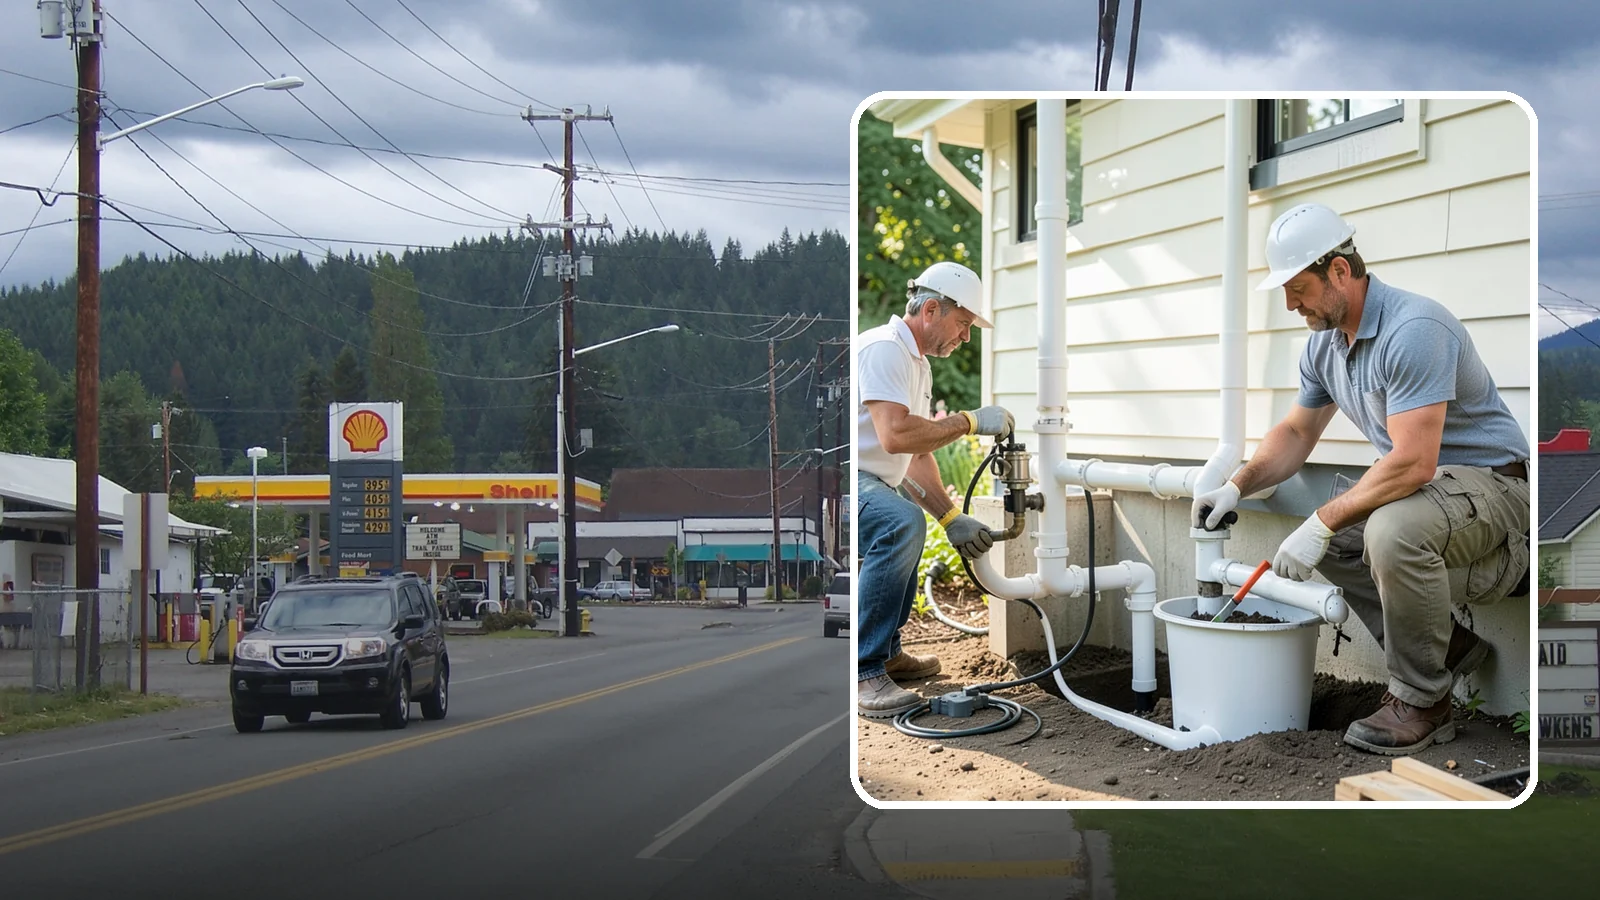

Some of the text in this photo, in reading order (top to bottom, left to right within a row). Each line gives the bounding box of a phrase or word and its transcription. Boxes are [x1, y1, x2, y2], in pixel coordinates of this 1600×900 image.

[365, 480, 383, 490] 395
[490, 484, 547, 499] Shell
[365, 494, 383, 504] 405
[365, 508, 383, 518] 415
[365, 522, 383, 532] 429
[1538, 643, 1567, 665] AID
